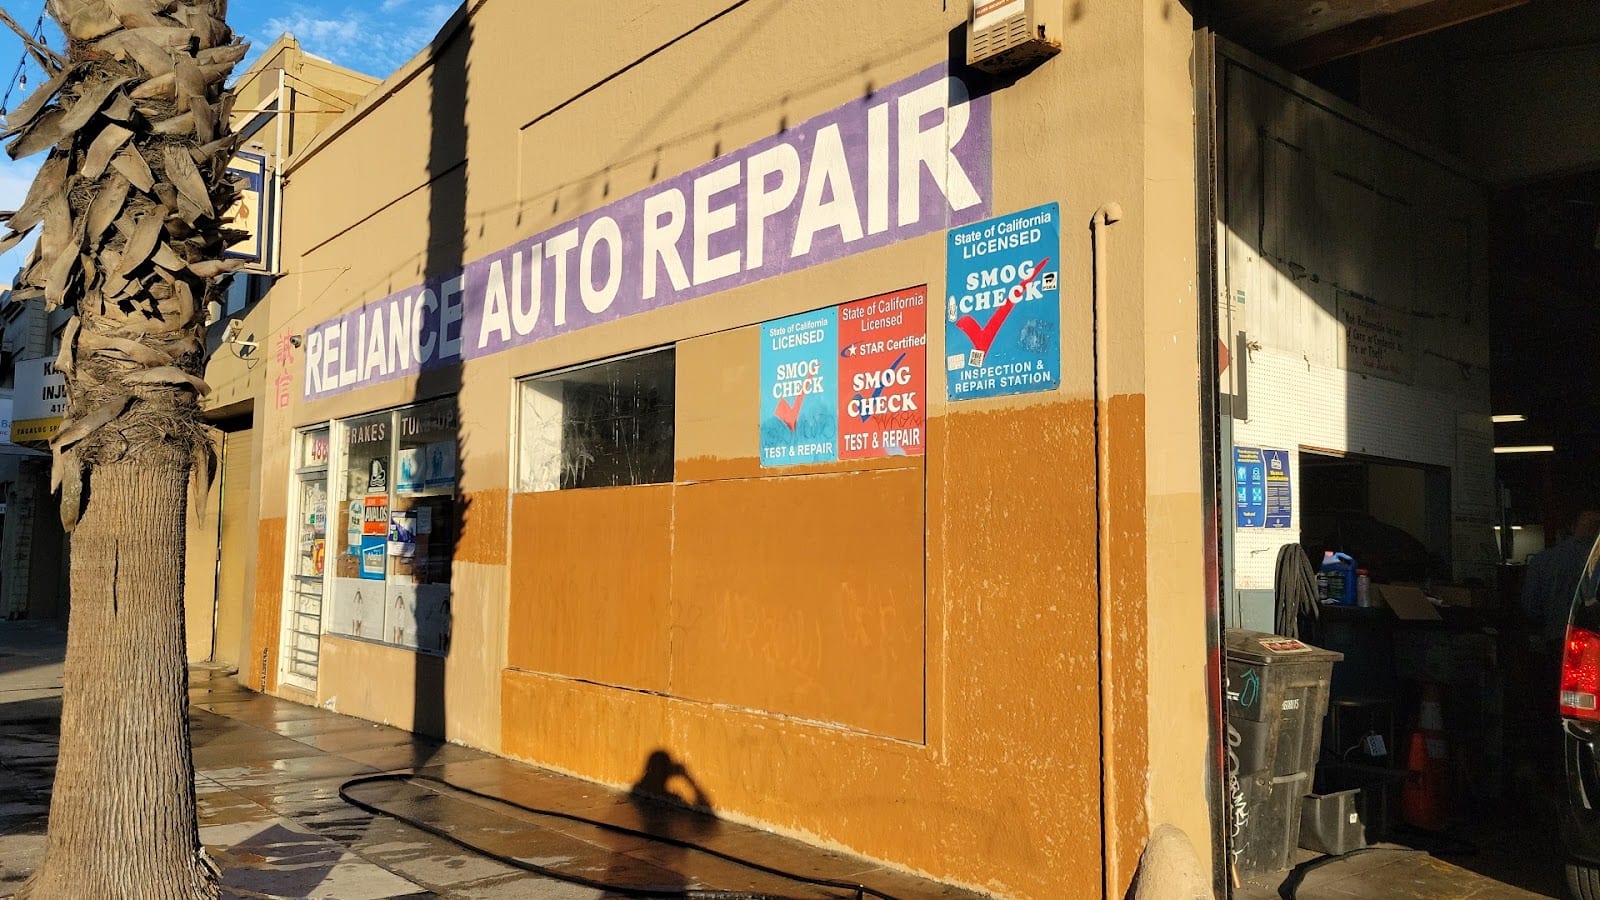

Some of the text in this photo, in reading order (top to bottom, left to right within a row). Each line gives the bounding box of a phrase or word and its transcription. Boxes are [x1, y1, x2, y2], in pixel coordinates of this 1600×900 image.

[304, 75, 983, 396] RELIANCE AUTO REPAIR
[955, 211, 1052, 246] State of California
[963, 228, 1041, 260] LICENSED
[966, 260, 1036, 291] SMOG
[842, 294, 924, 321] State of California
[959, 280, 1044, 314] CHECK
[769, 318, 828, 337] State of California
[861, 313, 903, 332] Licensed
[772, 329, 825, 351] LICENSED
[859, 333, 927, 356] STAR Certified
[44, 360, 65, 377] KA
[776, 359, 821, 381] SMOG
[852, 366, 912, 392] SMOG
[960, 360, 1032, 381] INSPECTION
[1036, 359, 1045, 370] &
[772, 376, 825, 399] CHECK
[955, 371, 1051, 394] REPAIR STATION
[847, 392, 919, 418] CHECK
[764, 442, 833, 459] TEST & REPAIR
[844, 428, 921, 451] TEST & REPAIR
[365, 507, 388, 522] AVALOS
